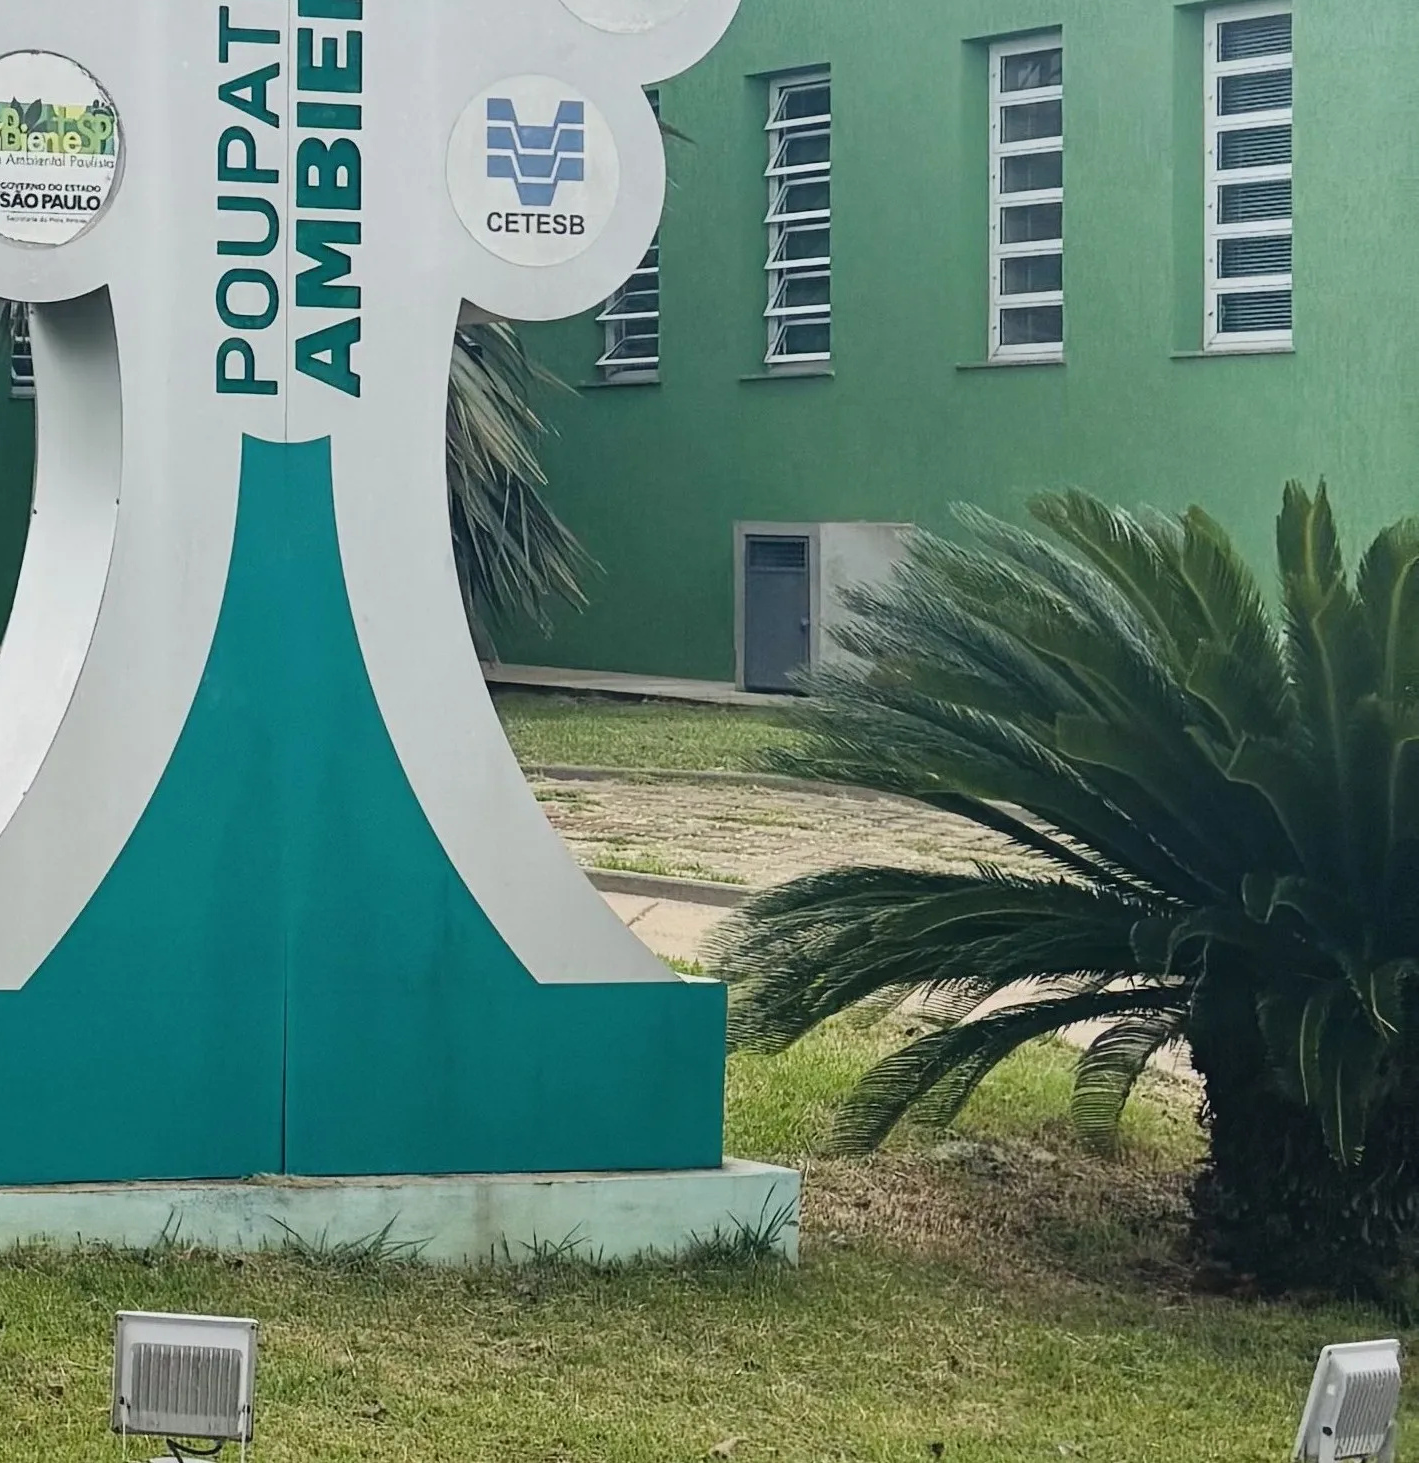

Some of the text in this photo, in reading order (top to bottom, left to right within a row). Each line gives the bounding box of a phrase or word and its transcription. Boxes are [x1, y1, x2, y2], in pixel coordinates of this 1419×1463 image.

[5, 153, 66, 168] Ambiental
[70, 155, 115, 170] Paulista
[48, 183, 63, 192] DO
[0, 190, 101, 211] SÃO PAULO
[486, 211, 585, 235] CETESB
